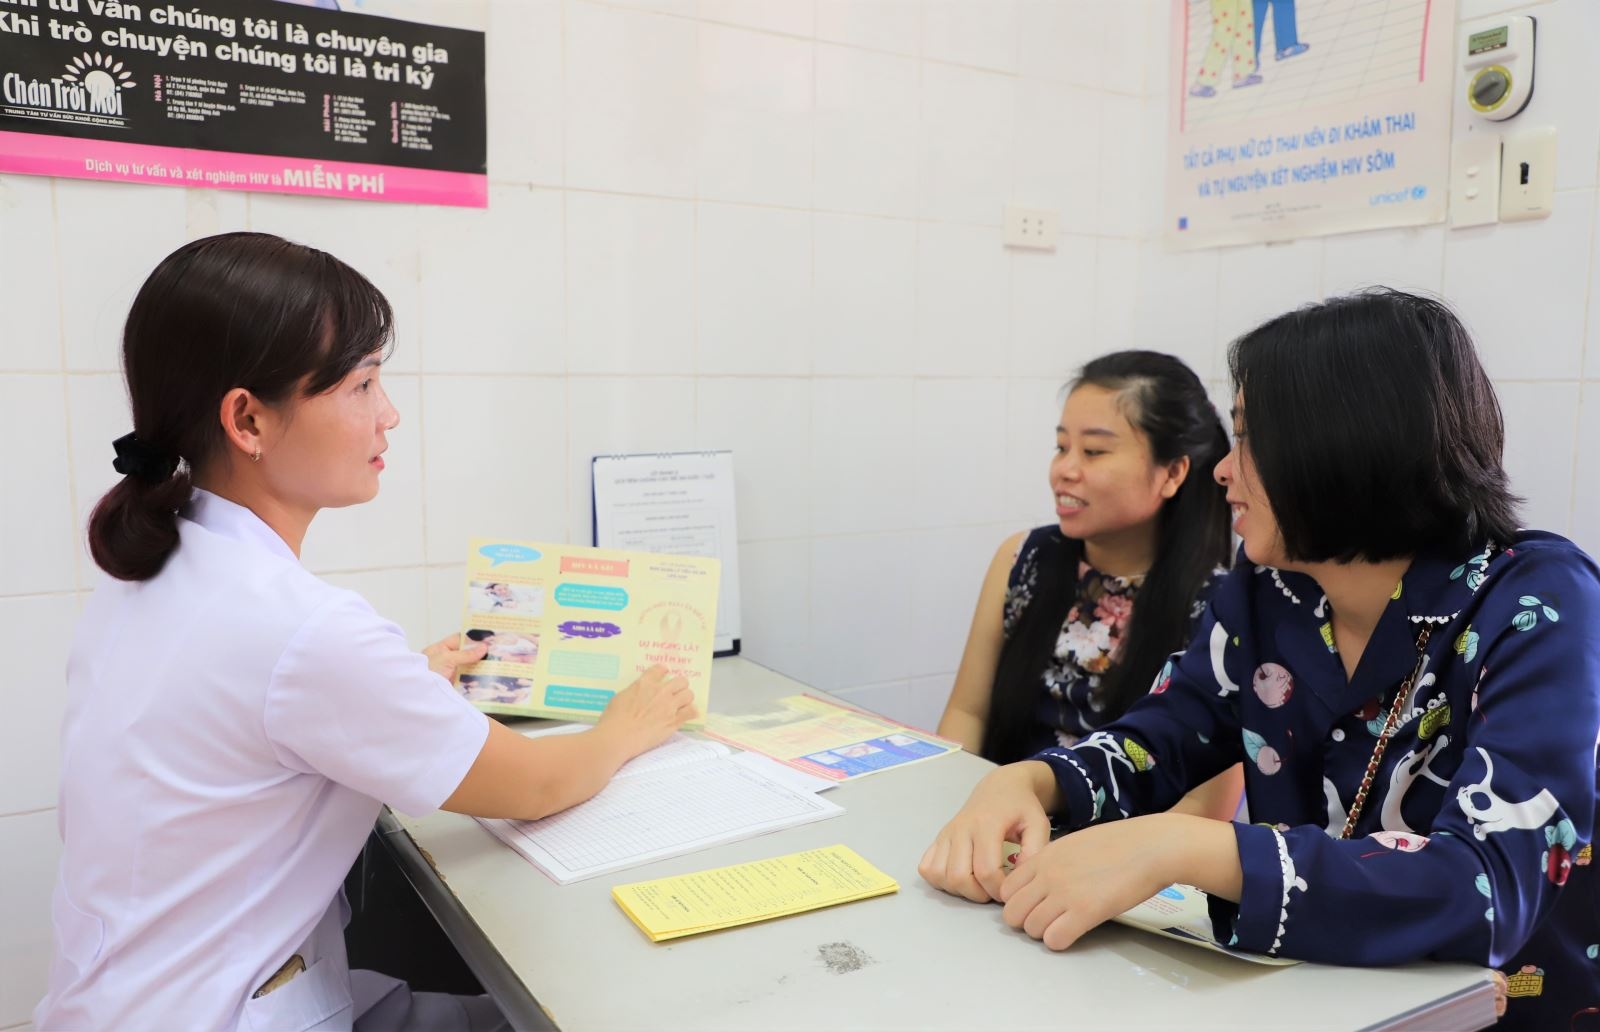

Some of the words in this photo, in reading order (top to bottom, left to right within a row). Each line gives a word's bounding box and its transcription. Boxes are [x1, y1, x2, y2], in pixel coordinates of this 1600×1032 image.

[48, 18, 92, 43] trò
[101, 27, 207, 60] chuyện
[215, 42, 296, 73] chúng
[303, 52, 337, 75] tôi
[344, 57, 367, 78] là
[372, 60, 400, 82] tri
[150, 5, 236, 38] chúng
[243, 17, 278, 40] tôi
[285, 23, 309, 45] là
[315, 30, 407, 58] chuyên
[412, 42, 448, 64] gia
[3, 72, 52, 108] Chân
[51, 77, 87, 111] Trời
[1344, 115, 1382, 141] KHÁM
[1385, 112, 1416, 134] THAI
[85, 158, 112, 174] Dịch
[115, 164, 129, 175] vụ
[147, 162, 167, 177] vấn
[170, 166, 184, 179] và
[186, 167, 203, 180] xét
[206, 169, 247, 185] nghiệm
[249, 173, 270, 185] HIV
[283, 164, 342, 190] MIỄN
[347, 173, 385, 194] PHÍ
[1292, 157, 1338, 183] NGHIỆM
[1341, 158, 1363, 175] HIV
